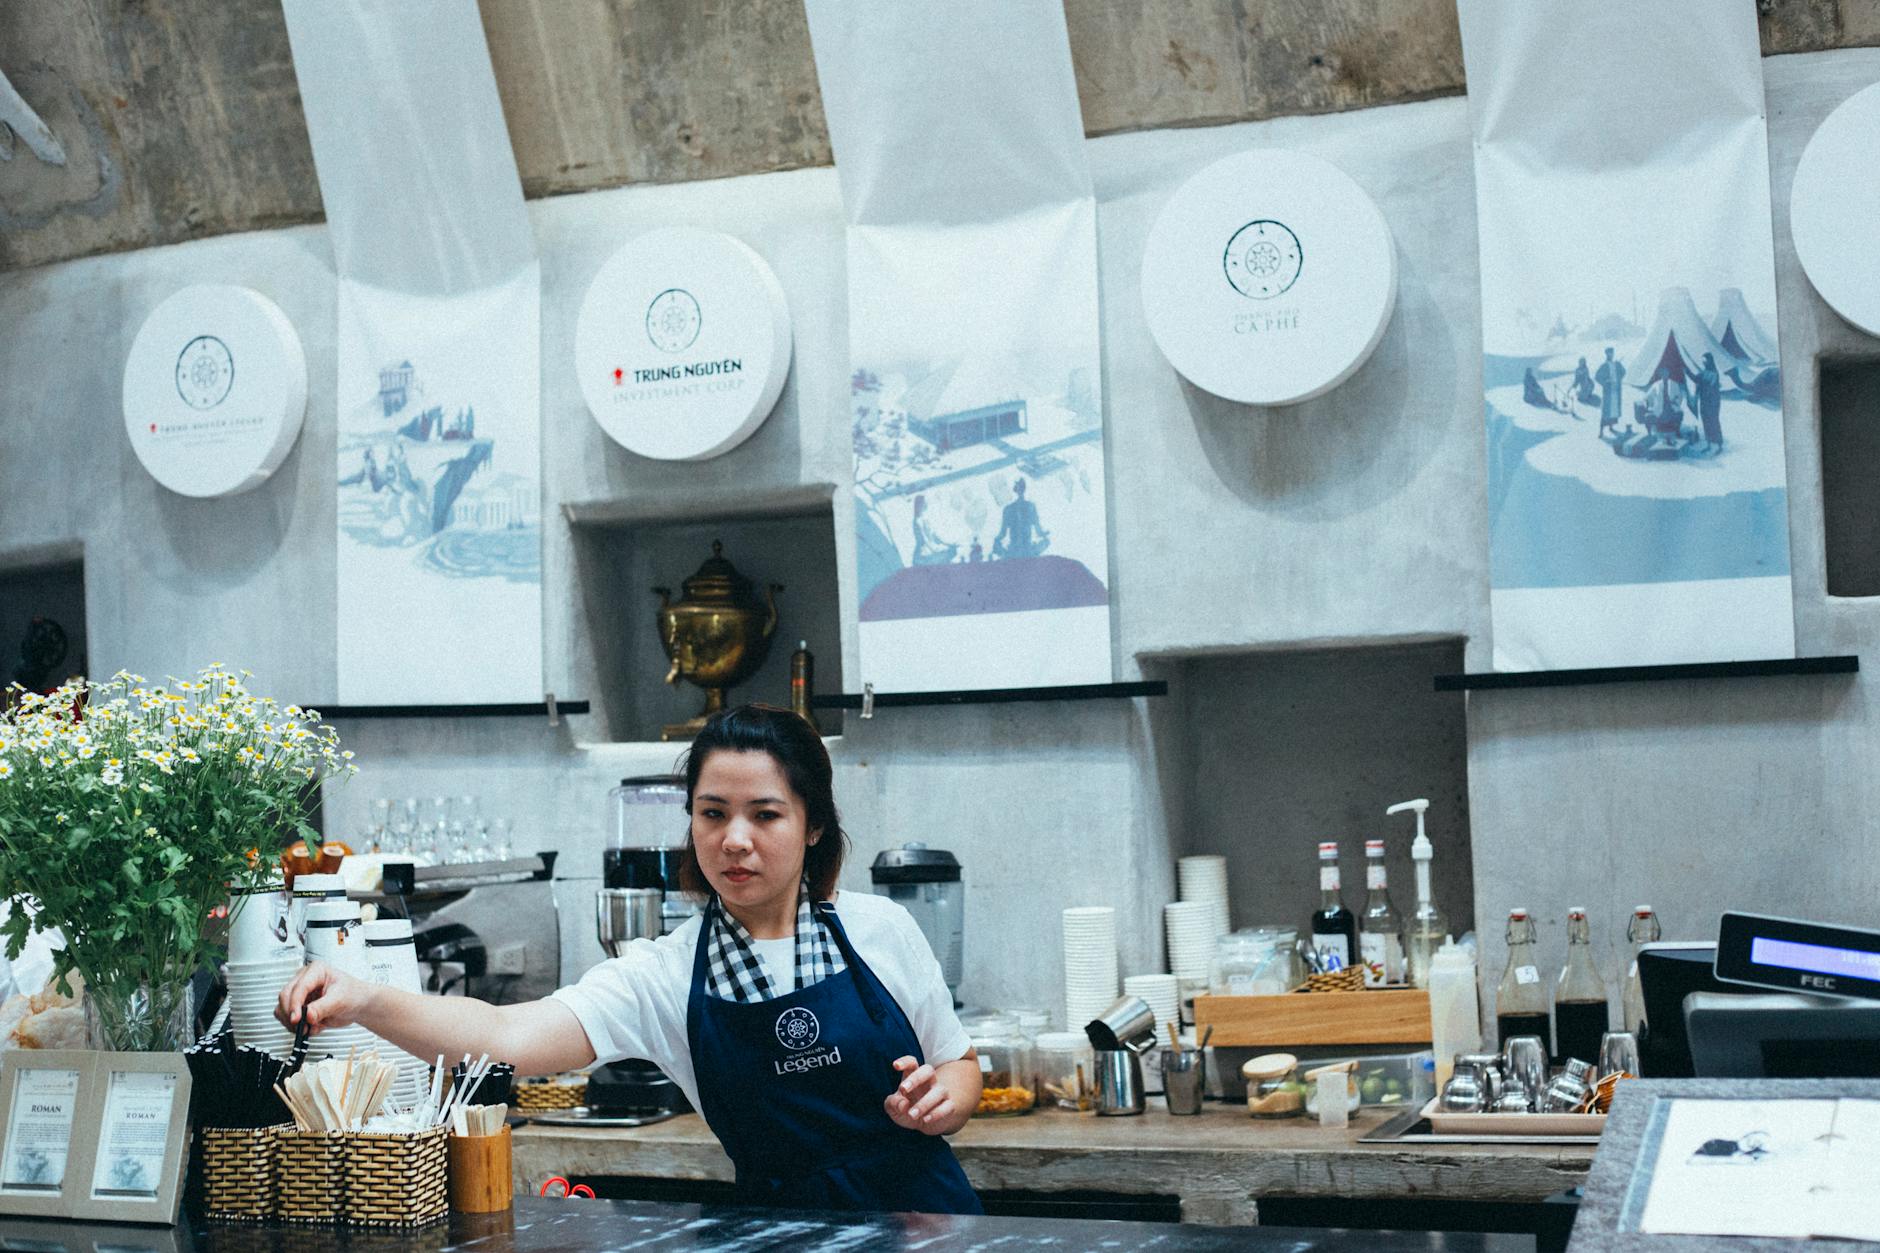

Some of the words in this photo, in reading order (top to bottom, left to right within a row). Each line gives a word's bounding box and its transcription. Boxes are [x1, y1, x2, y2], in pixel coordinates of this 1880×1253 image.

[634, 365, 681, 383] TRUNG
[1801, 974, 1836, 989] FEC
[774, 1046, 842, 1075] Legend
[31, 1104, 62, 1113] ROMAN
